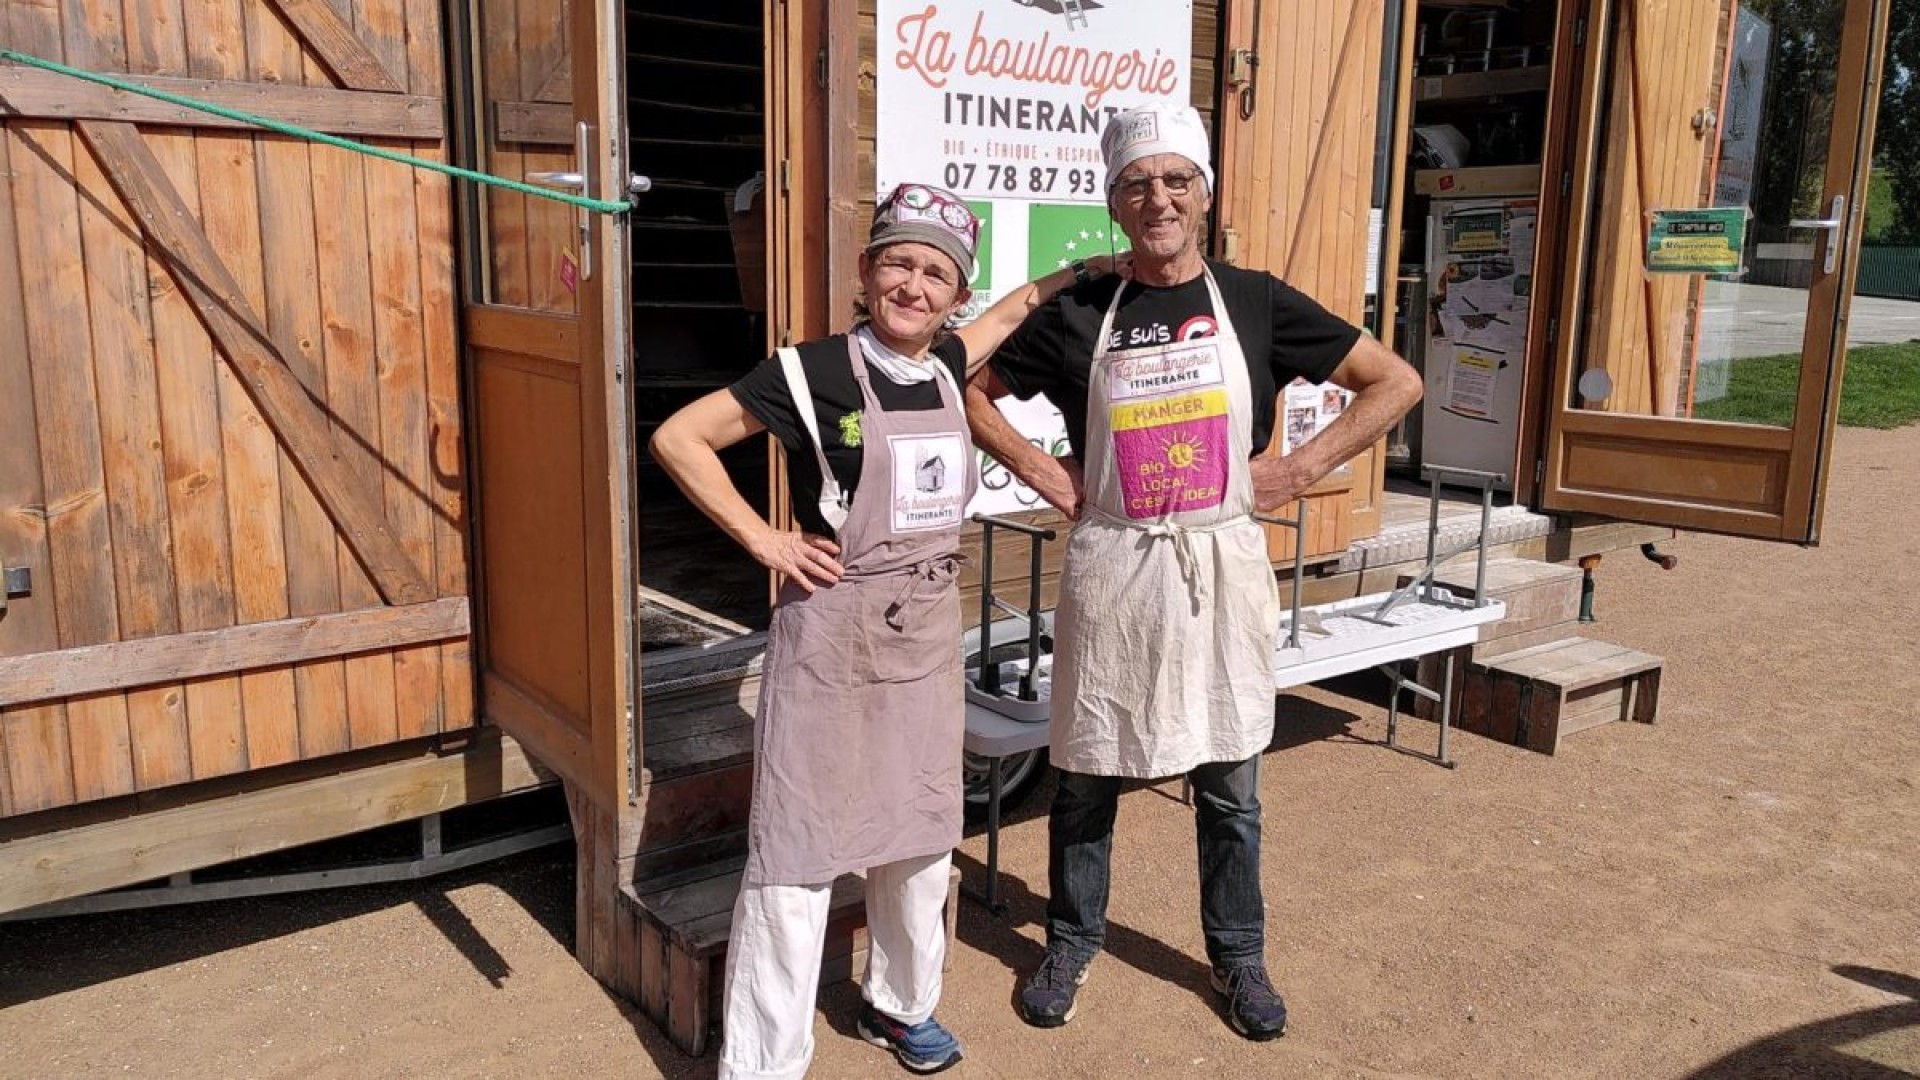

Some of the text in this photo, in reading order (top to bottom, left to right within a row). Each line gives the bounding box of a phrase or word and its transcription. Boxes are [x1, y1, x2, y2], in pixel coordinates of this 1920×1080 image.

[896, 4, 1178, 109] La boulangerie
[944, 92, 1128, 135] ITINERANT
[944, 140, 1100, 163] BIO ÉTHIQUE RESPON
[944, 162, 1096, 194] 07 78 87 93
[1130, 322, 1171, 344] SUIS
[1135, 351, 1213, 379] boulangerie
[1130, 369, 1200, 390] ITINERANTE
[1133, 398, 1204, 423] MANGER
[1140, 462, 1165, 475] BIO
[1142, 477, 1188, 492] LOCAL
[907, 508, 952, 521] ITINERANTE
